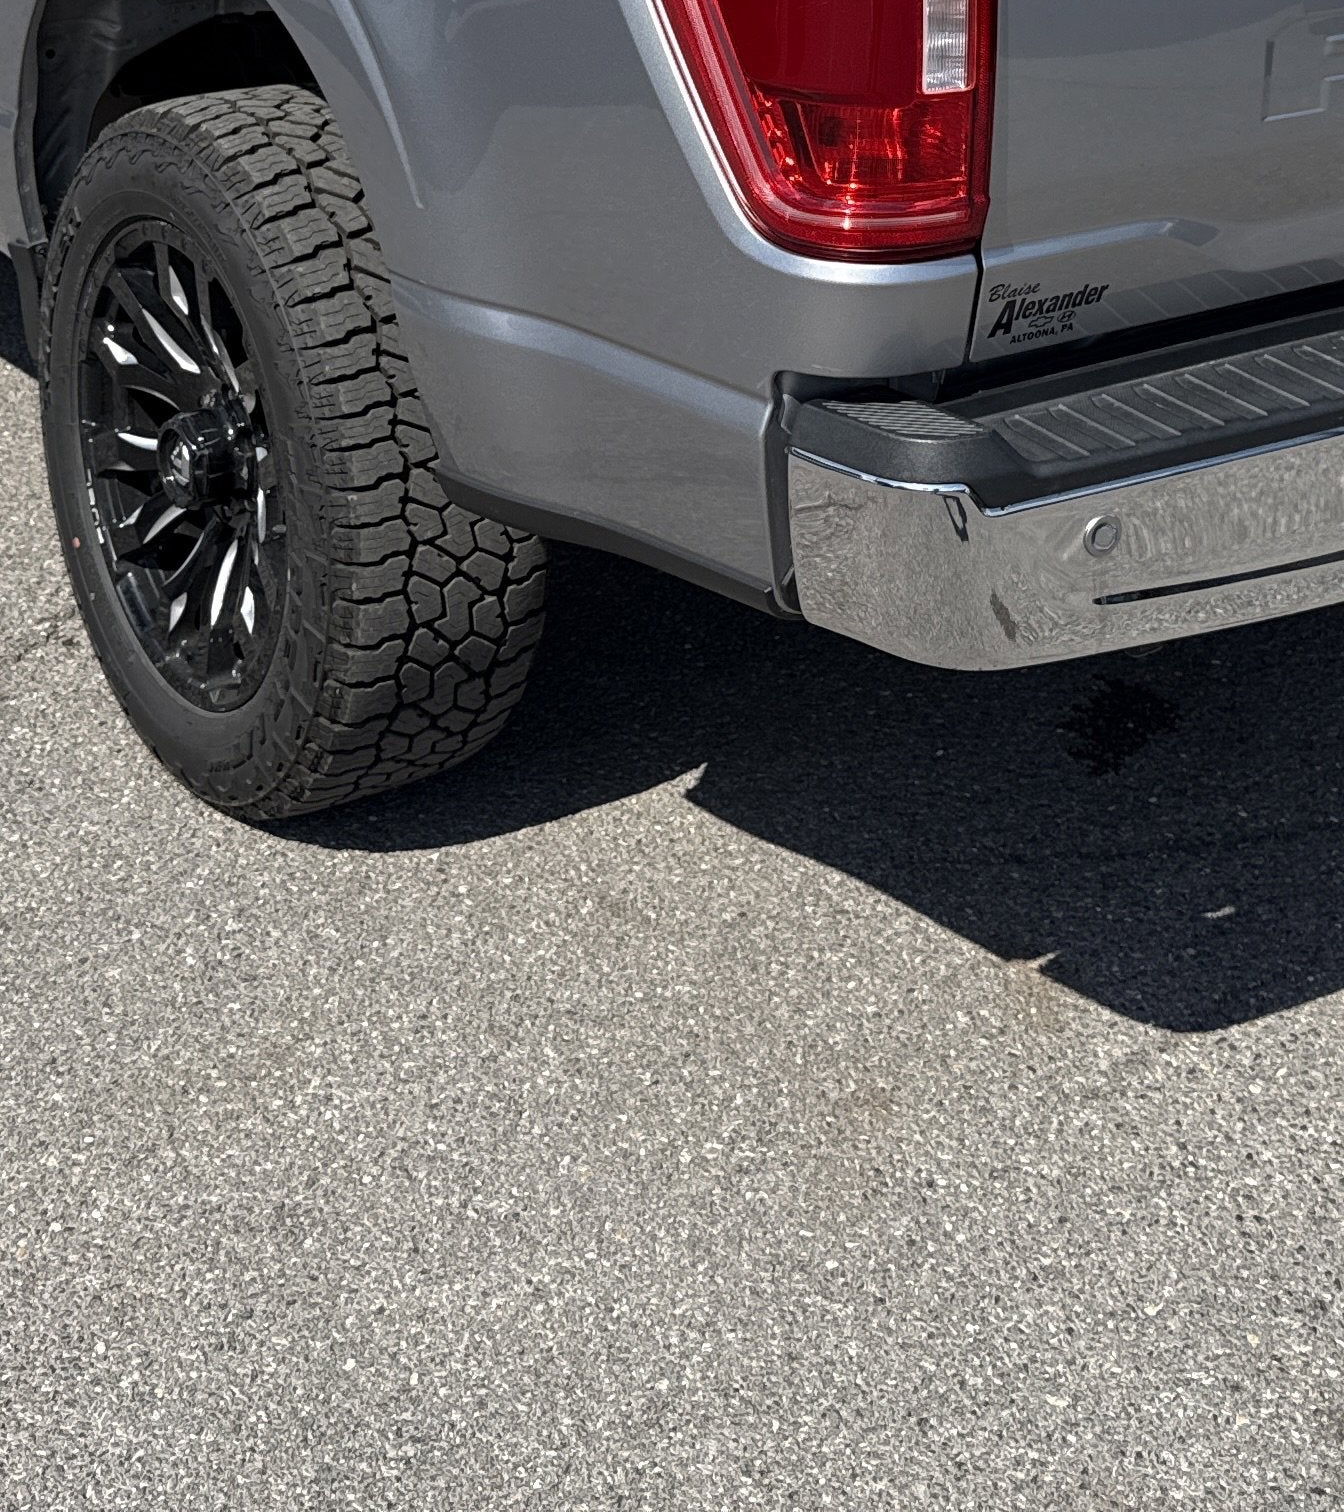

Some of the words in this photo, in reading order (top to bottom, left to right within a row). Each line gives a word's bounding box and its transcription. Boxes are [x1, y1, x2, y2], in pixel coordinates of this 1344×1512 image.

[988, 282, 1041, 303] Blaise
[987, 283, 1110, 339] Alexander
[1060, 322, 1074, 333] PA
